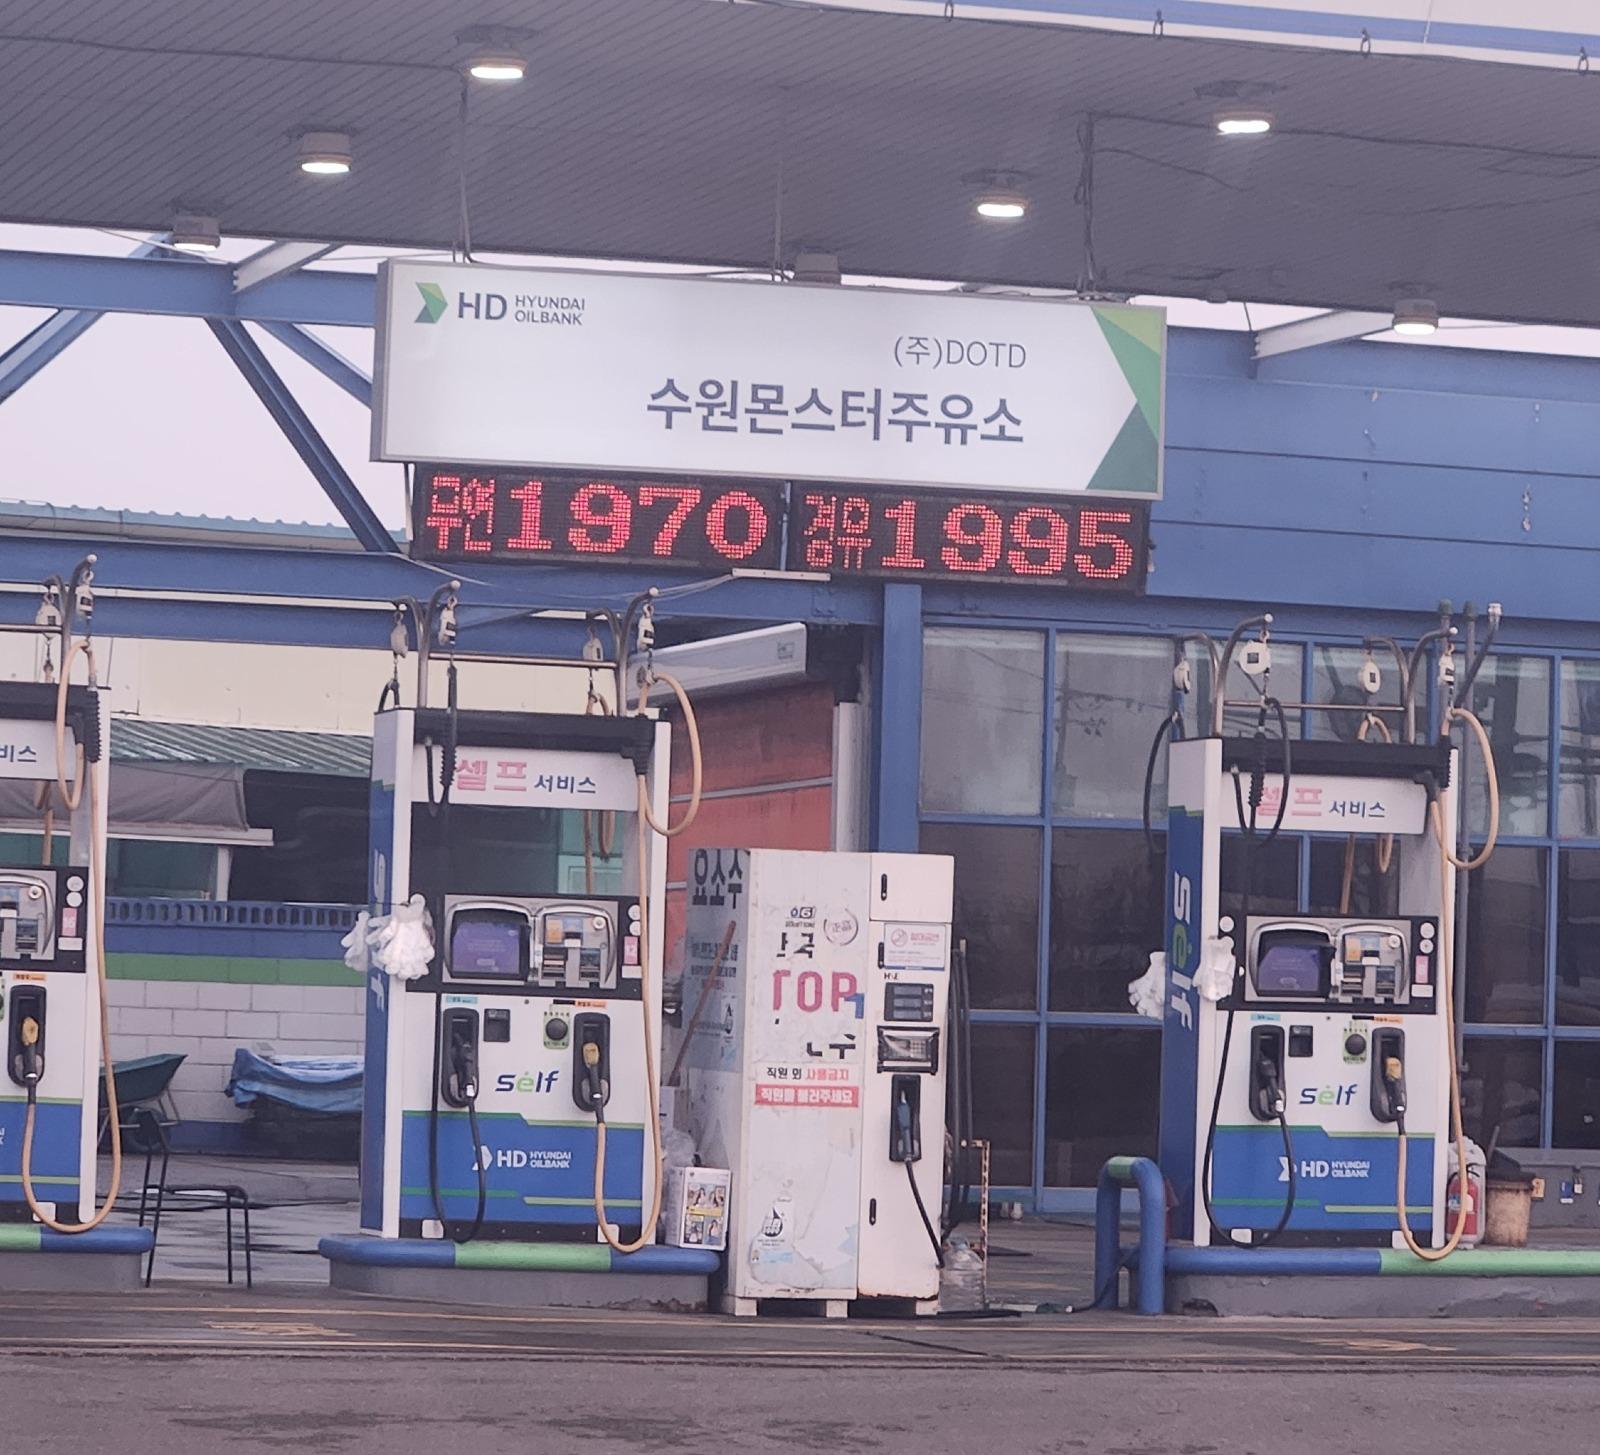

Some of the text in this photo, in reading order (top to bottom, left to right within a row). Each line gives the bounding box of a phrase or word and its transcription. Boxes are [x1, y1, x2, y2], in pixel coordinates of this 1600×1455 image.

[458, 292, 507, 320] HD
[515, 295, 585, 311] HYUNDAI
[515, 310, 582, 326] OILBANK
[894, 336, 1027, 369] (주)DOTD
[647, 378, 1024, 446] 수원몬스터주유소
[507, 481, 767, 559] 1970
[804, 495, 1133, 579] 경유 1995
[455, 759, 596, 793] 셀프 서비스
[1329, 801, 1385, 818] 서비스
[692, 849, 743, 909] 요소수
[767, 1067, 788, 1080] 직원
[497, 1150, 527, 1168] HD
[530, 1151, 572, 1160] HYUNDAI
[530, 1159, 570, 1169] OILBANK
[1301, 1161, 1330, 1178] HD
[1331, 1161, 1371, 1170] HYUNDAI
[1331, 1169, 1369, 1179] OILBANK
